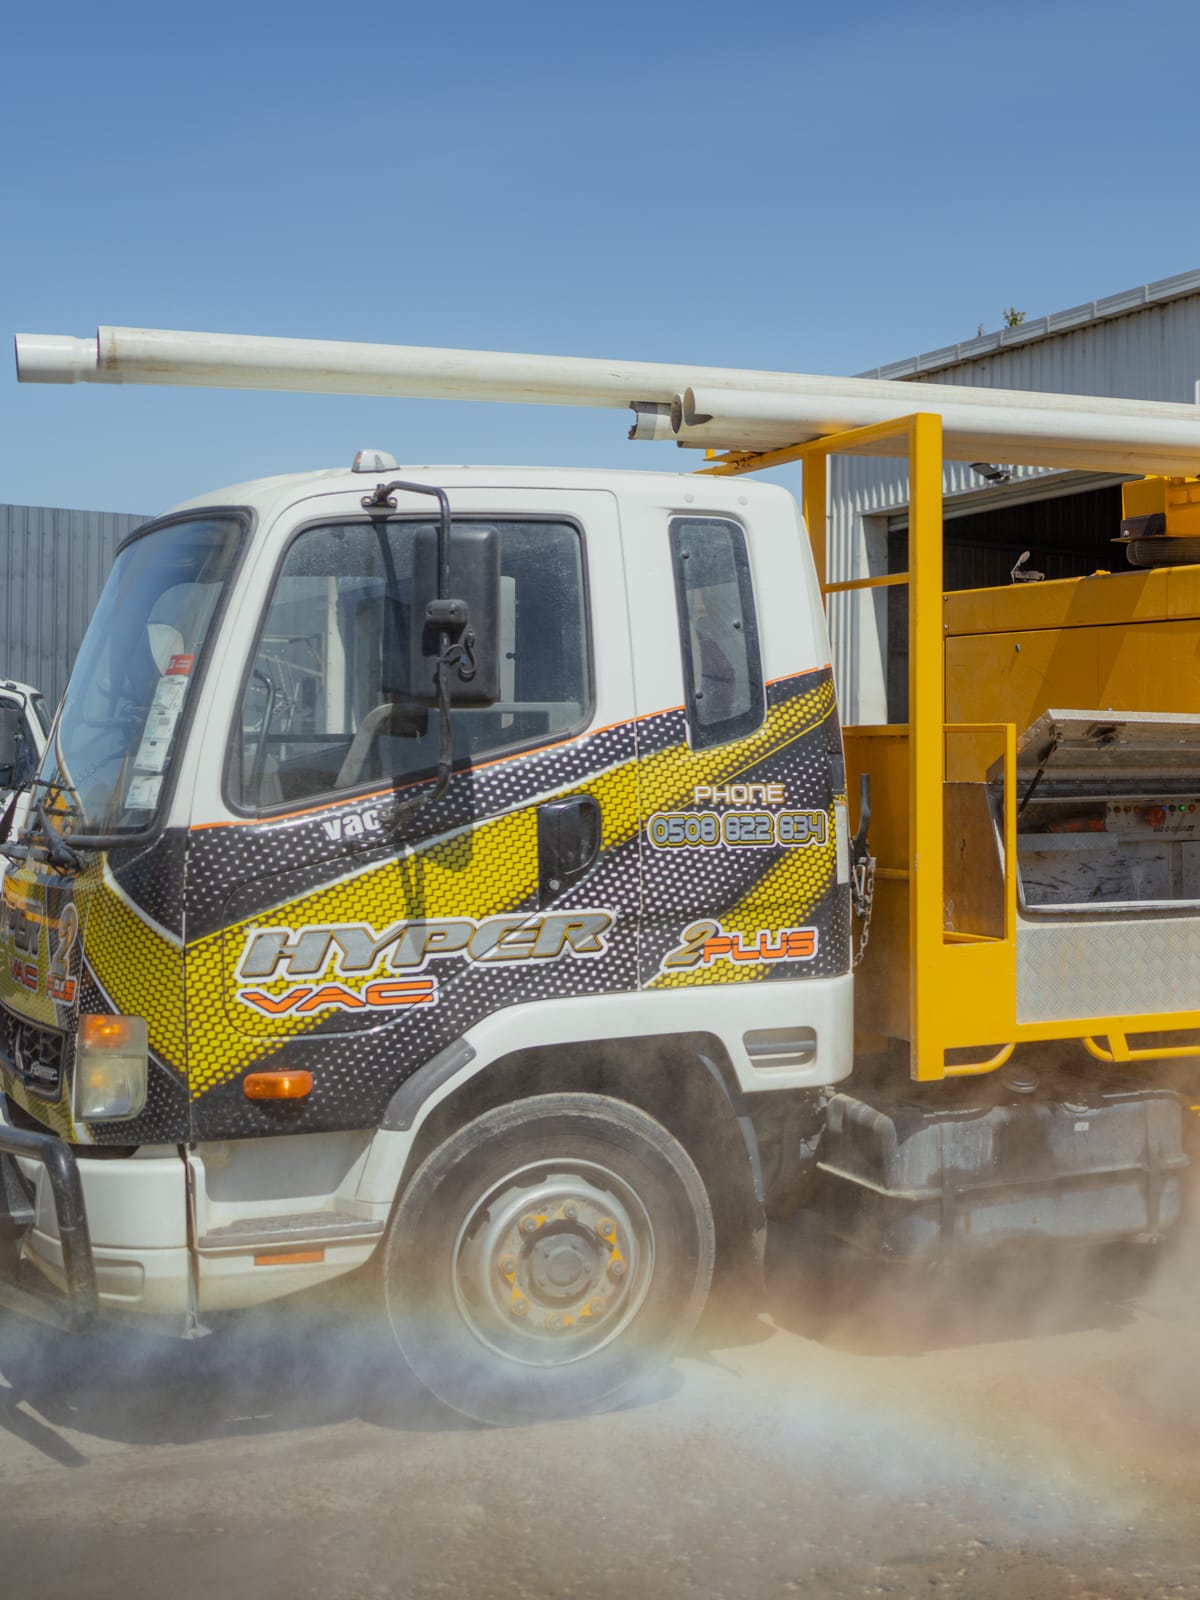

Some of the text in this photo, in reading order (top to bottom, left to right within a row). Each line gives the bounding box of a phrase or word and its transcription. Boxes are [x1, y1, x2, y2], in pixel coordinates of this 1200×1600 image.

[693, 784, 785, 805] PHONE
[322, 809, 381, 841] vac
[652, 812, 824, 845] 0508 822 834
[239, 912, 613, 977] HYPER
[240, 980, 434, 1014] VAC
